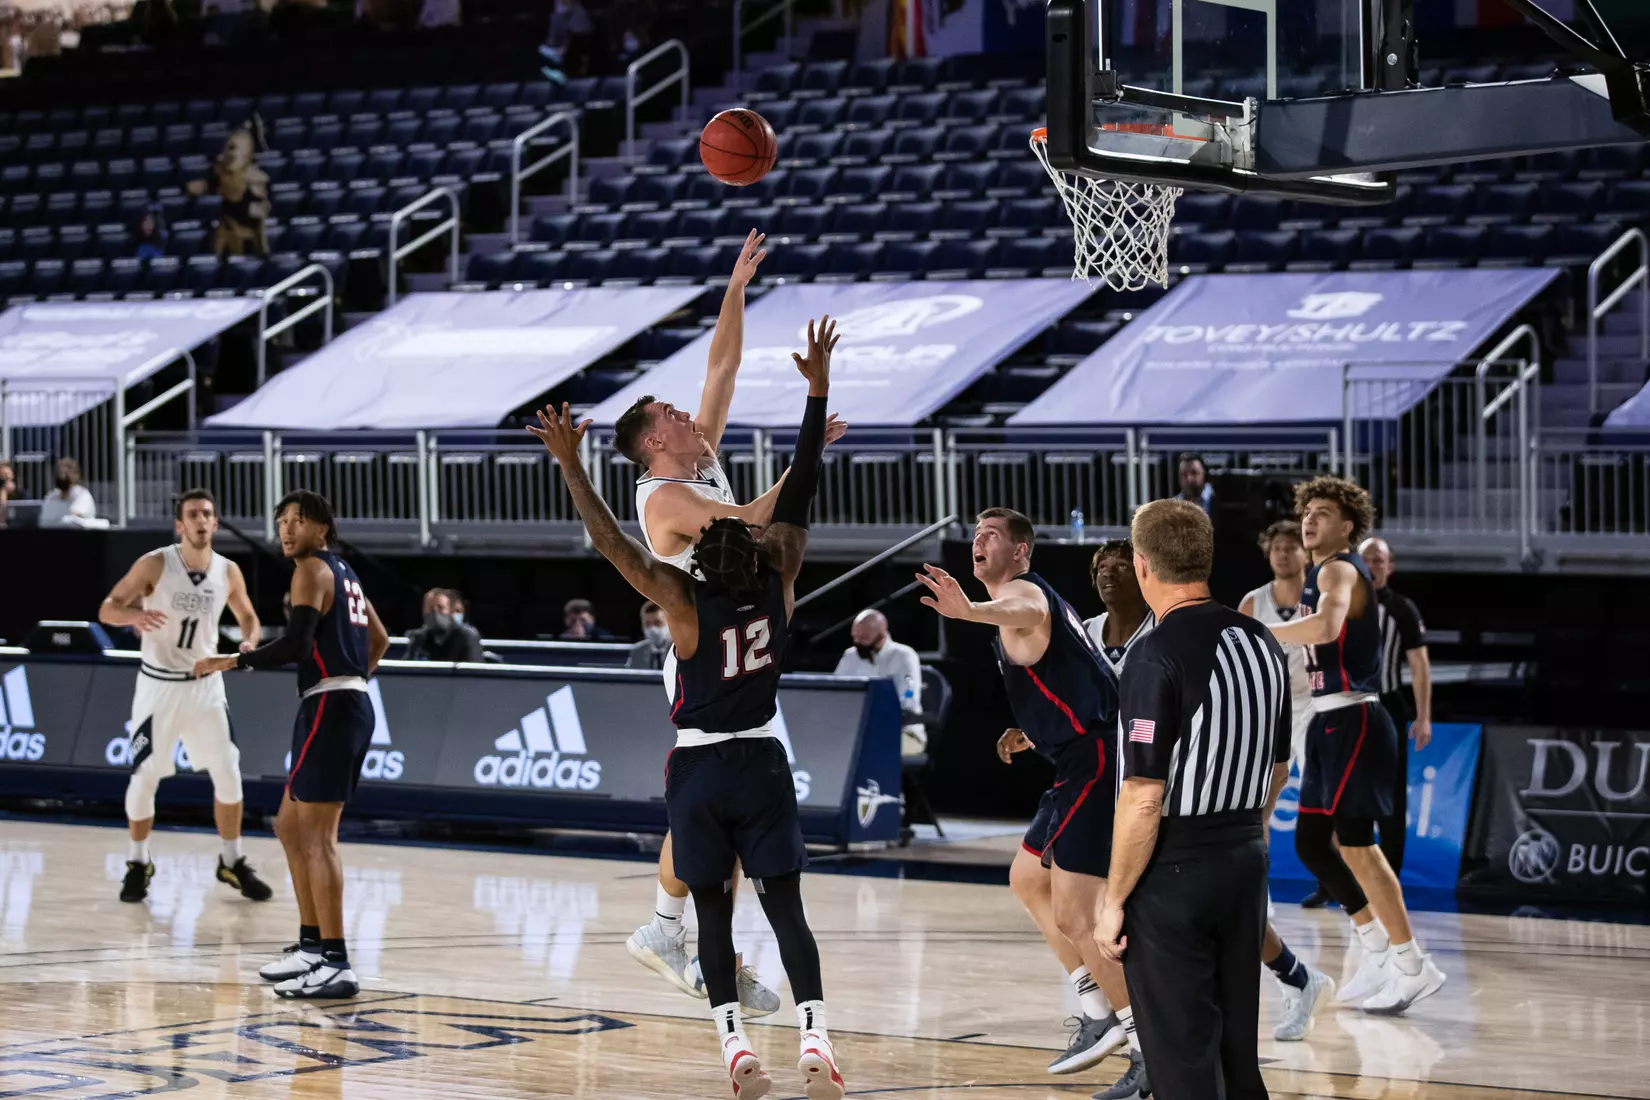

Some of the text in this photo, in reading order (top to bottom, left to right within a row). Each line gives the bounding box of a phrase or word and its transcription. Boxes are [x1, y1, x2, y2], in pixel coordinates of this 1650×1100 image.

[1142, 321, 1469, 344] TOVEY/SHULTZ
[171, 591, 214, 614] CBU
[343, 577, 369, 627] 22
[177, 616, 200, 649] 11
[719, 615, 775, 681] 12
[473, 748, 602, 790] adidas
[1519, 738, 1650, 801] DU
[1567, 843, 1650, 876] BUIC
